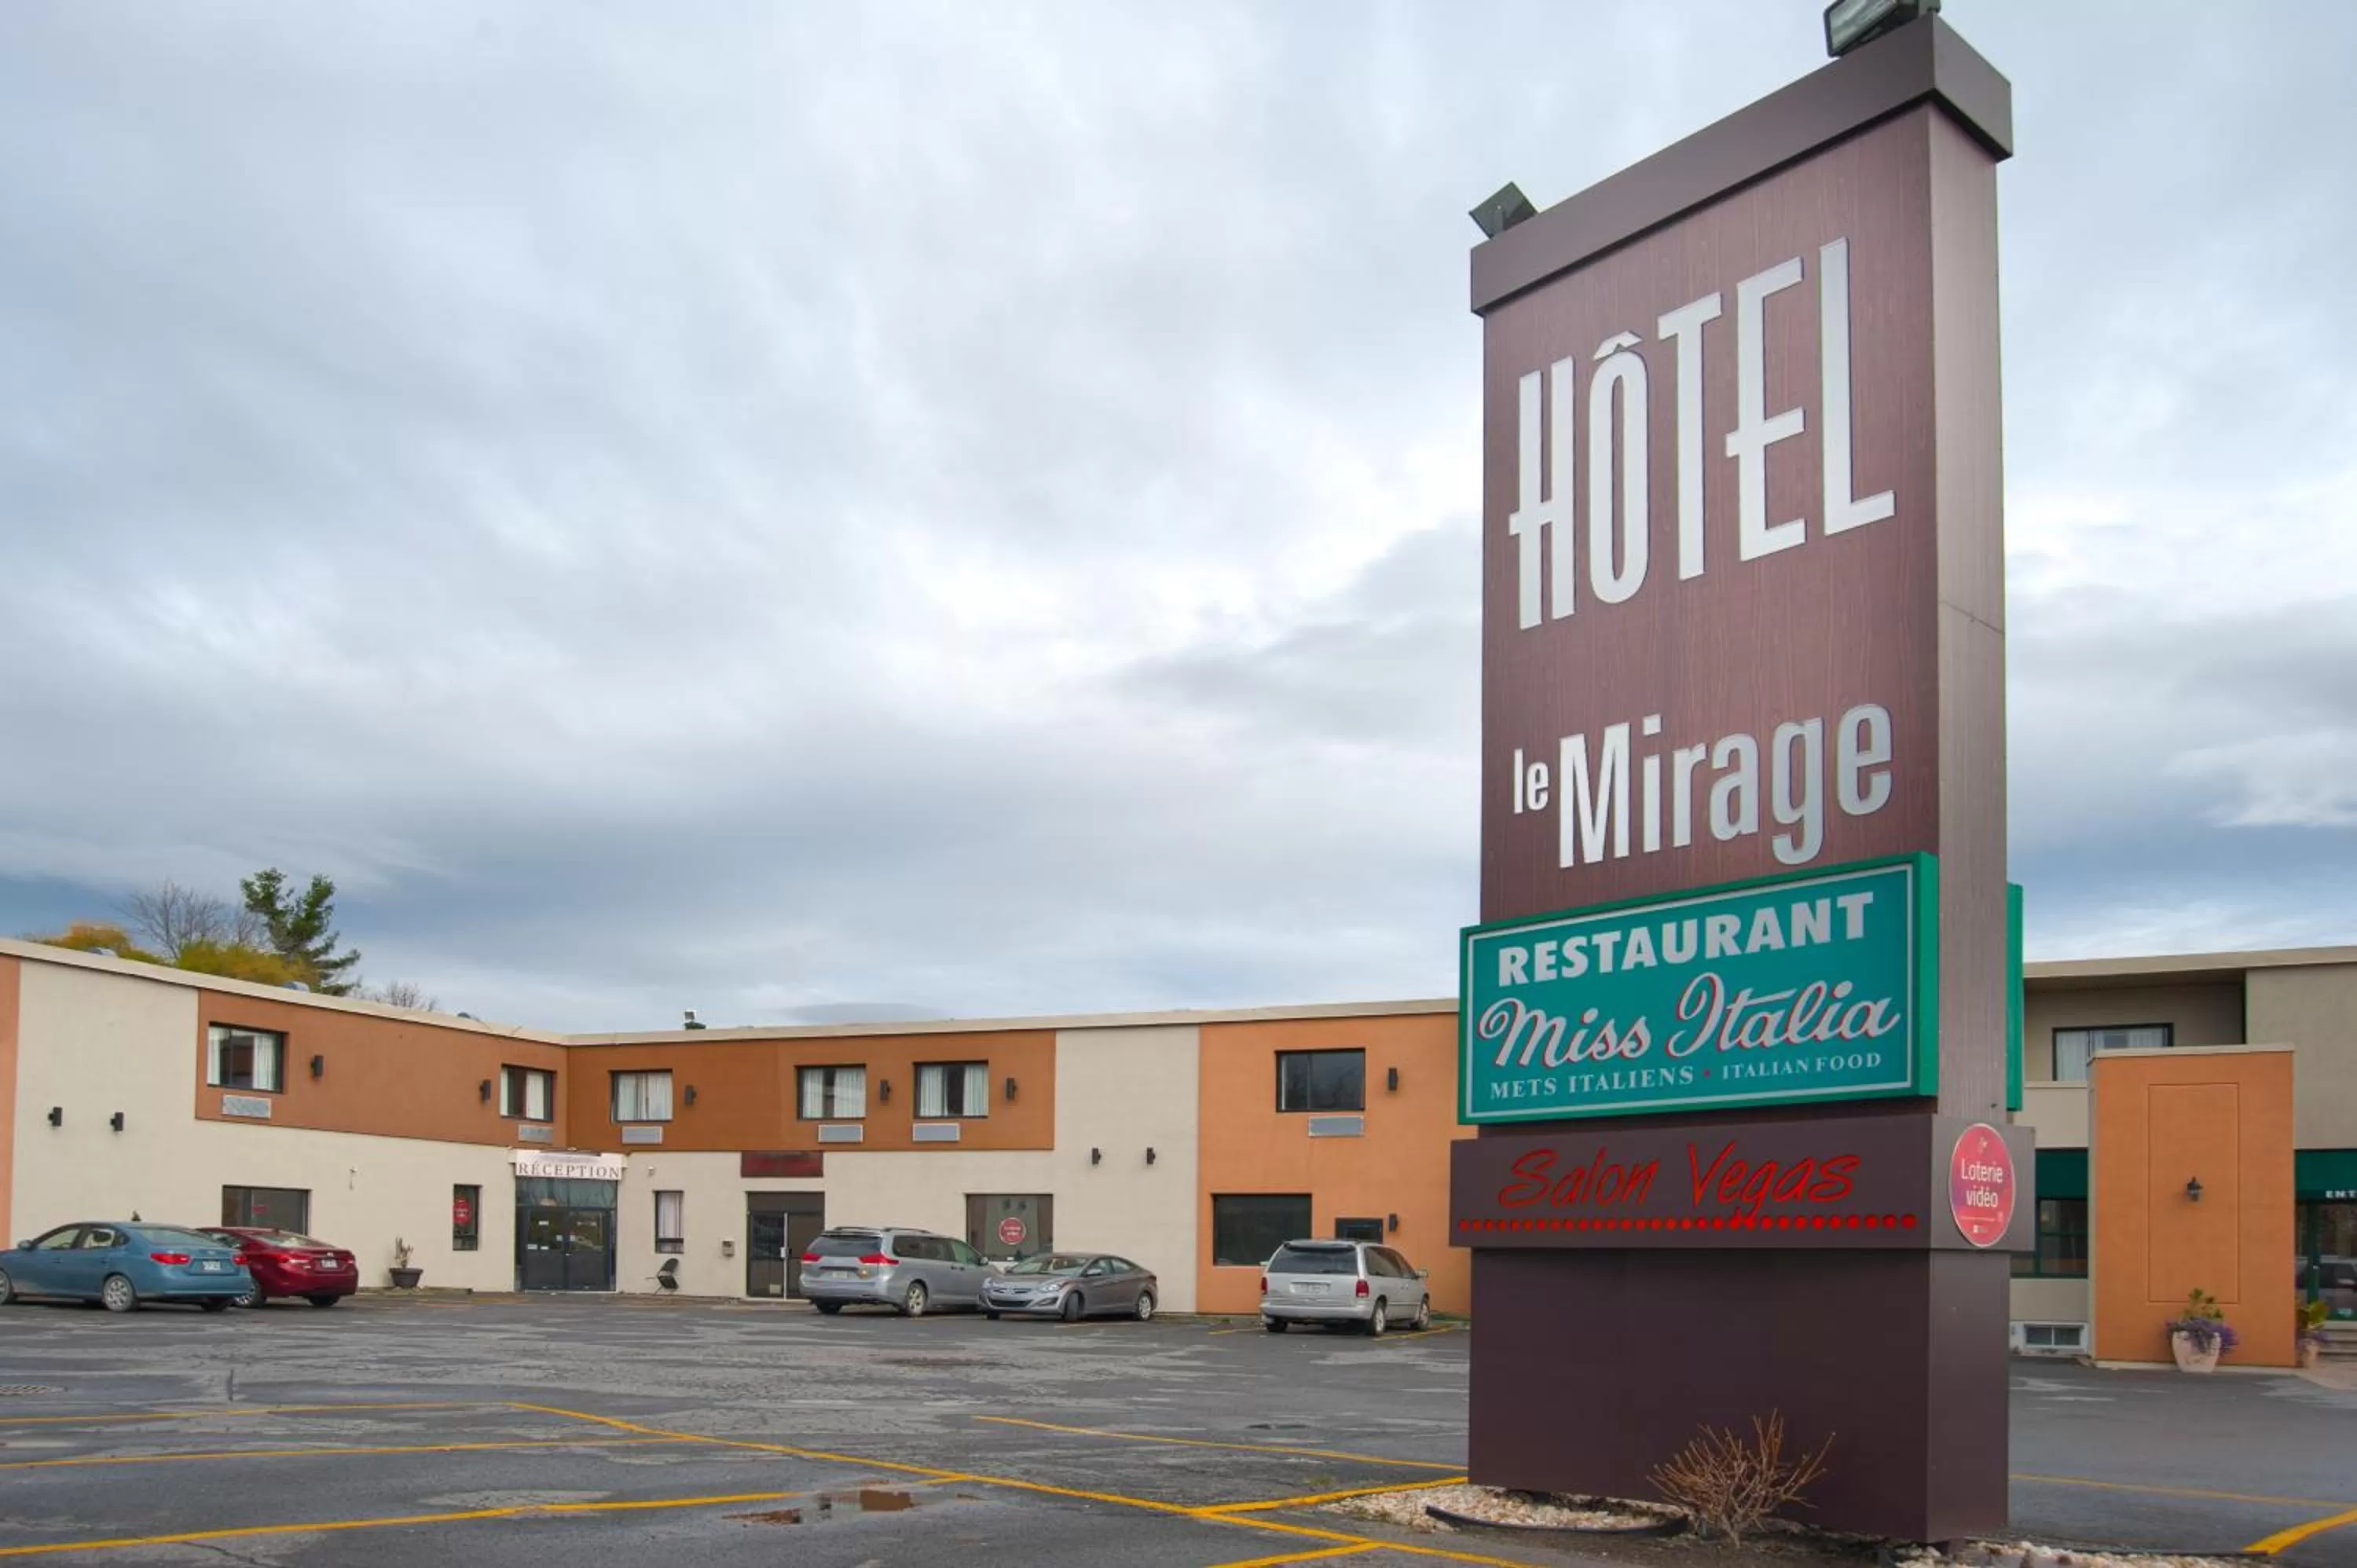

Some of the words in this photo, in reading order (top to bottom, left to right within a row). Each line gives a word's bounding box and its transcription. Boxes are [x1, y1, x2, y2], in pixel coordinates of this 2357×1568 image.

[1508, 236, 1896, 630] HÔTEL
[1513, 749, 1549, 814] le
[1559, 703, 1893, 868] Mirage
[1498, 892, 1874, 987] RESTAURANT
[1477, 998, 1651, 1068] Miss
[1666, 972, 1901, 1058] Italia
[1490, 1076, 1557, 1099] METS
[1568, 1065, 1695, 1094] ITALIENS
[1721, 1059, 1809, 1080] ITALIAN
[1815, 1052, 1882, 1073] FOOD
[519, 1160, 620, 1178] RÉCEPTION
[1497, 1145, 1660, 1208] Salon
[1688, 1140, 1861, 1222] Vegas
[1960, 1157, 2003, 1184] Loterie
[1966, 1184, 2000, 1208] vidéo
